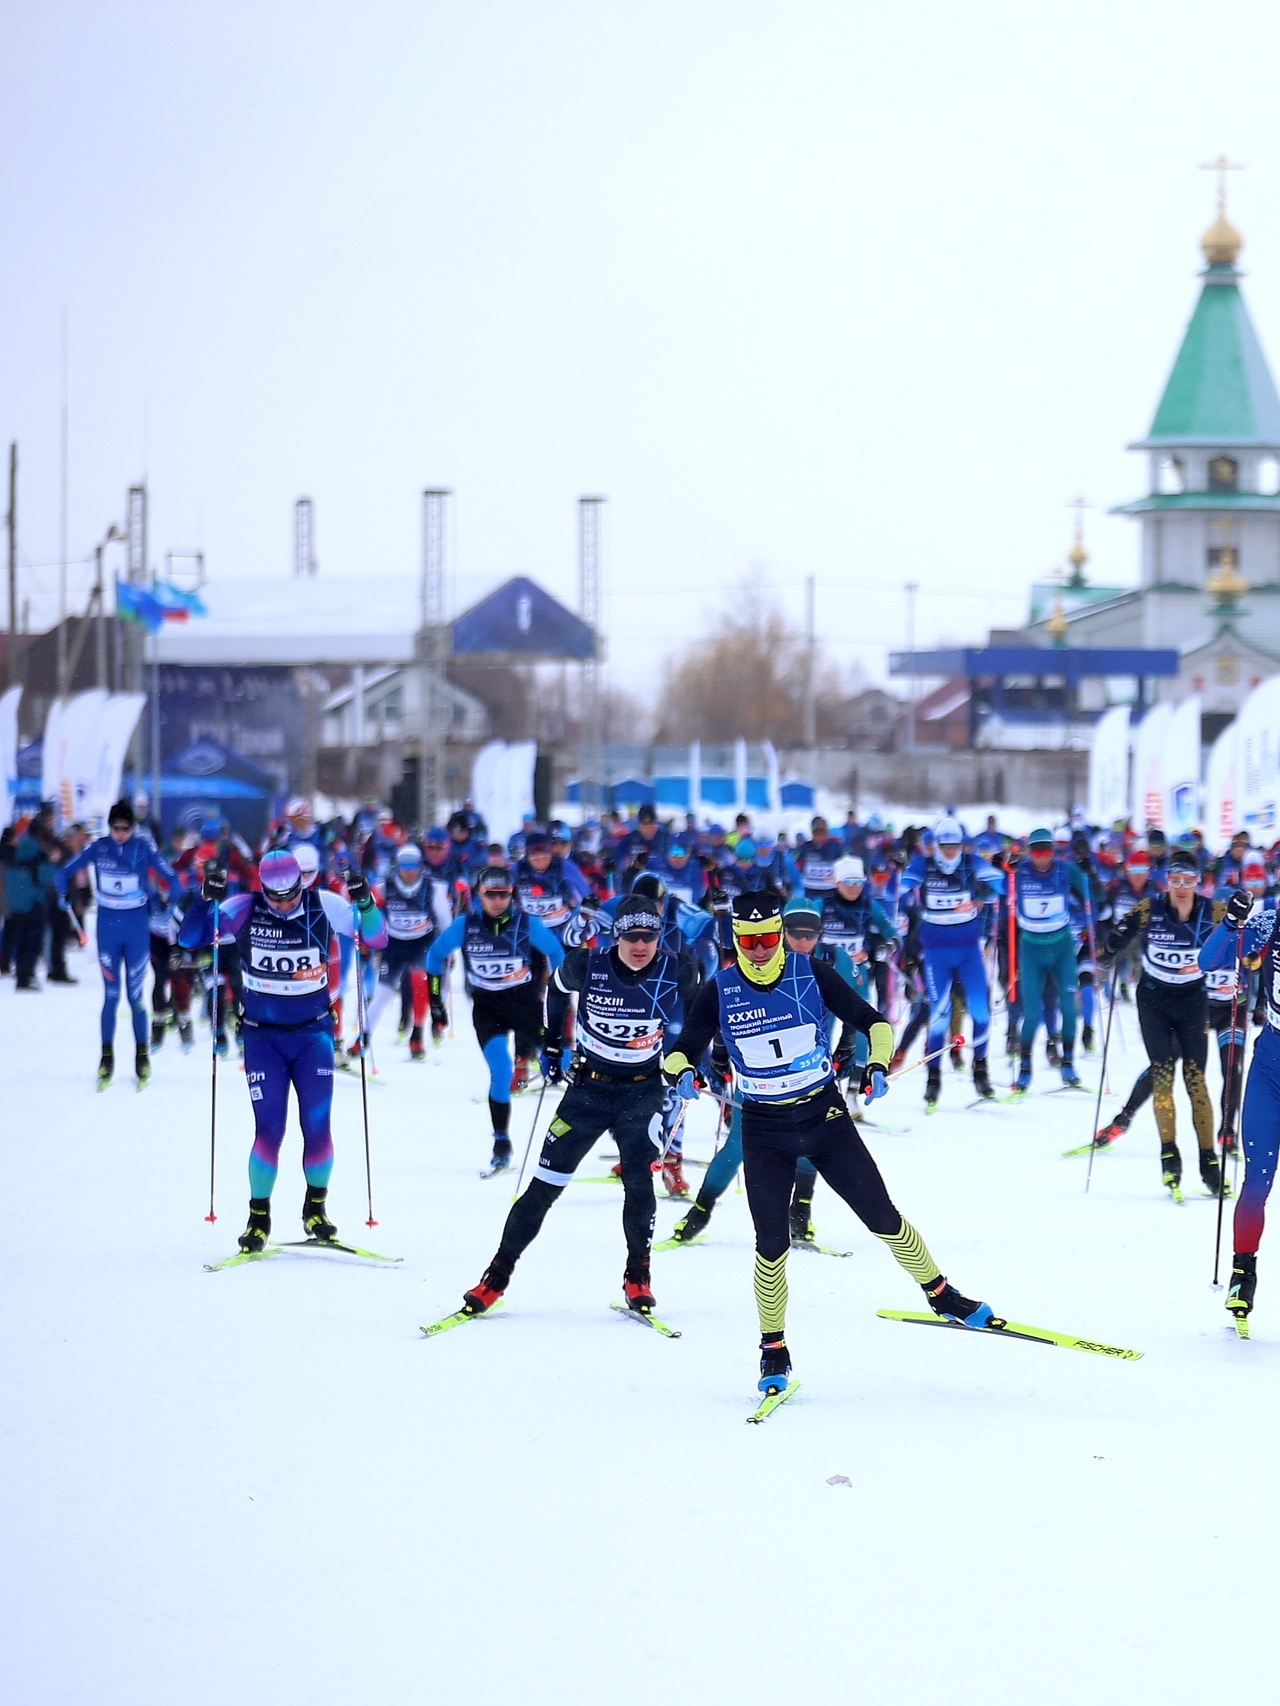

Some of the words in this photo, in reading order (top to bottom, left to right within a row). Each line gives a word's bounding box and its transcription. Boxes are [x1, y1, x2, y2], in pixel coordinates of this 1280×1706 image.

[1040, 902, 1049, 914] 7
[250, 926, 282, 938] XXXIII
[258, 956, 312, 973] 408
[1154, 953, 1196, 964] 405
[476, 963, 516, 976] 425
[586, 993, 624, 1007] XXXIII
[727, 1007, 767, 1024] XXXIII
[730, 1020, 761, 1031] ТРОИЦКИЙ
[762, 1013, 793, 1025] ЛЫЖНЫЙ
[595, 1022, 649, 1039] 428
[731, 1027, 761, 1036] МАРАФОН
[768, 1038, 784, 1059] 1
[799, 1060, 811, 1068] 25
[1073, 1340, 1125, 1356] FISCHER
